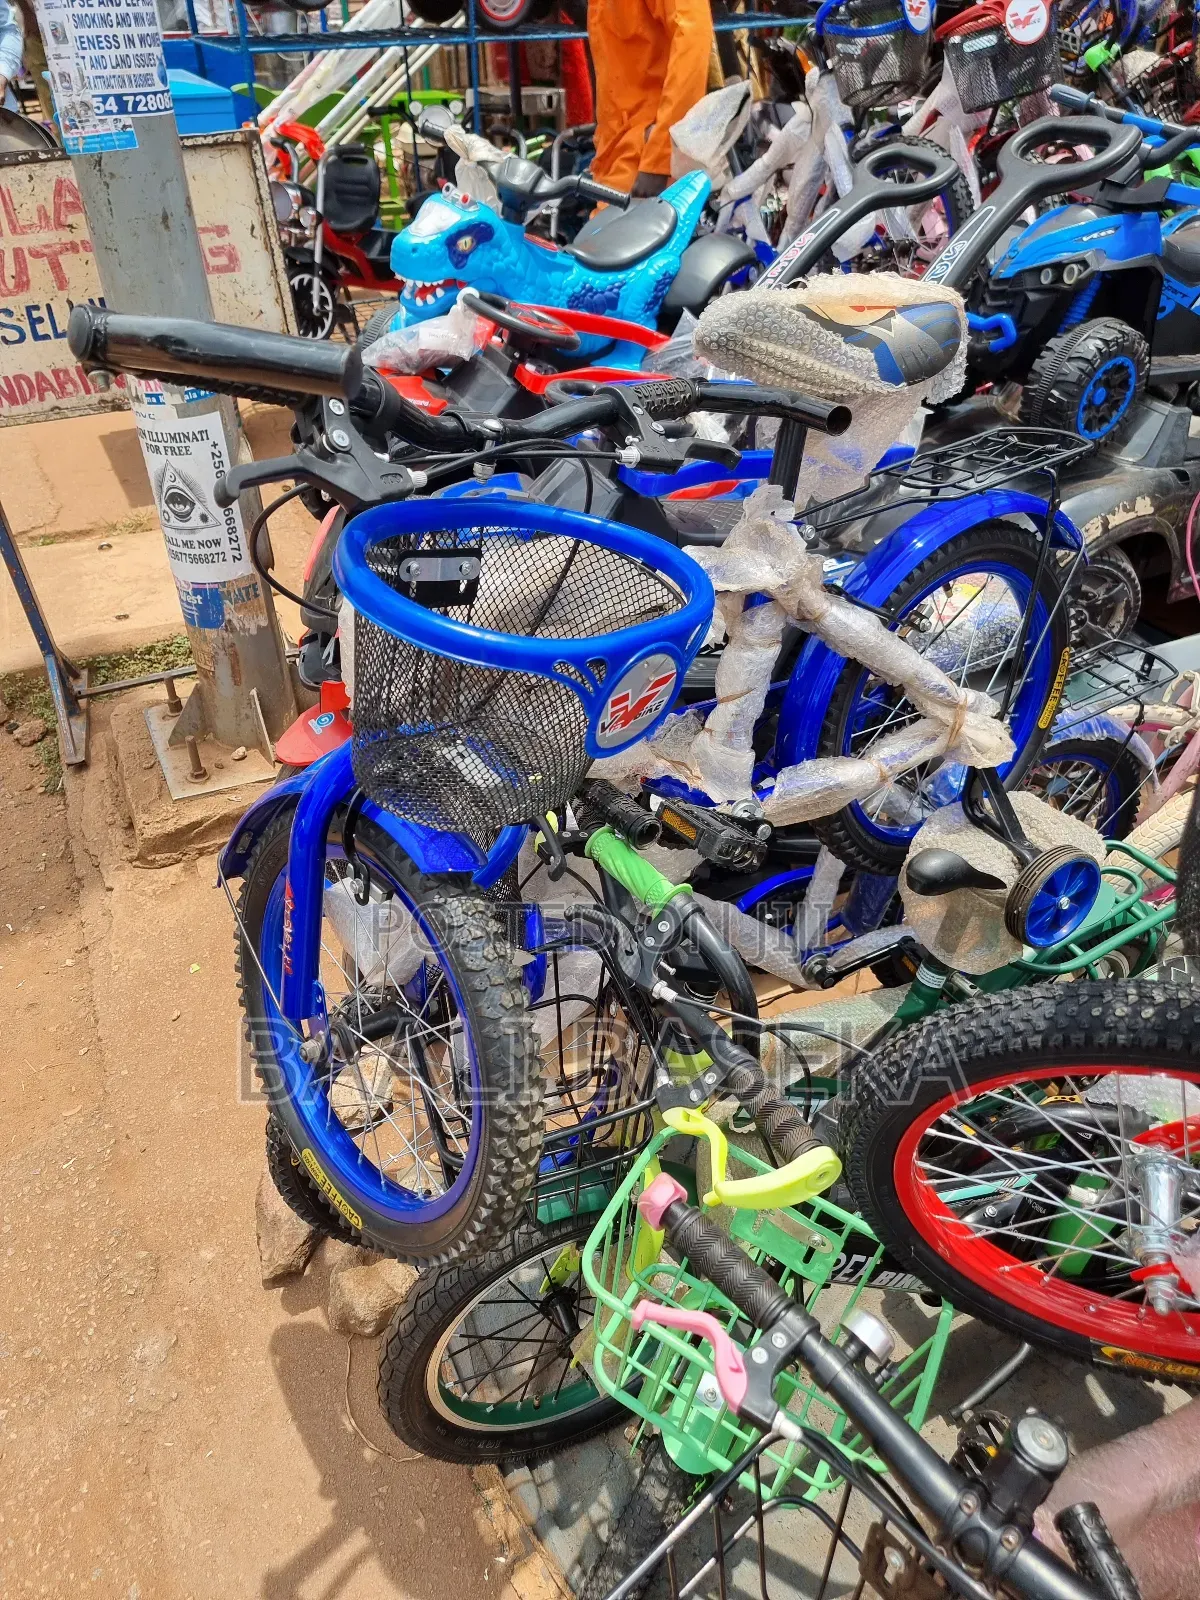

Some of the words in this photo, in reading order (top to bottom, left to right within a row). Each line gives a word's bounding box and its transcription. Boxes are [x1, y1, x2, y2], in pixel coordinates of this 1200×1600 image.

[72, 13, 113, 29] SMOKING
[115, 12, 131, 28] AND
[123, 33, 136, 49] IN
[90, 54, 107, 71] AND
[108, 54, 132, 70] LAND
[132, 52, 156, 69] ISSUES
[93, 74, 127, 90] ATTRACTION
[147, 428, 210, 444] ILLUMINATI
[145, 442, 162, 456] FOR
[163, 445, 193, 457] FREE
[181, 539, 195, 550] ME
[196, 537, 222, 549] NOW
